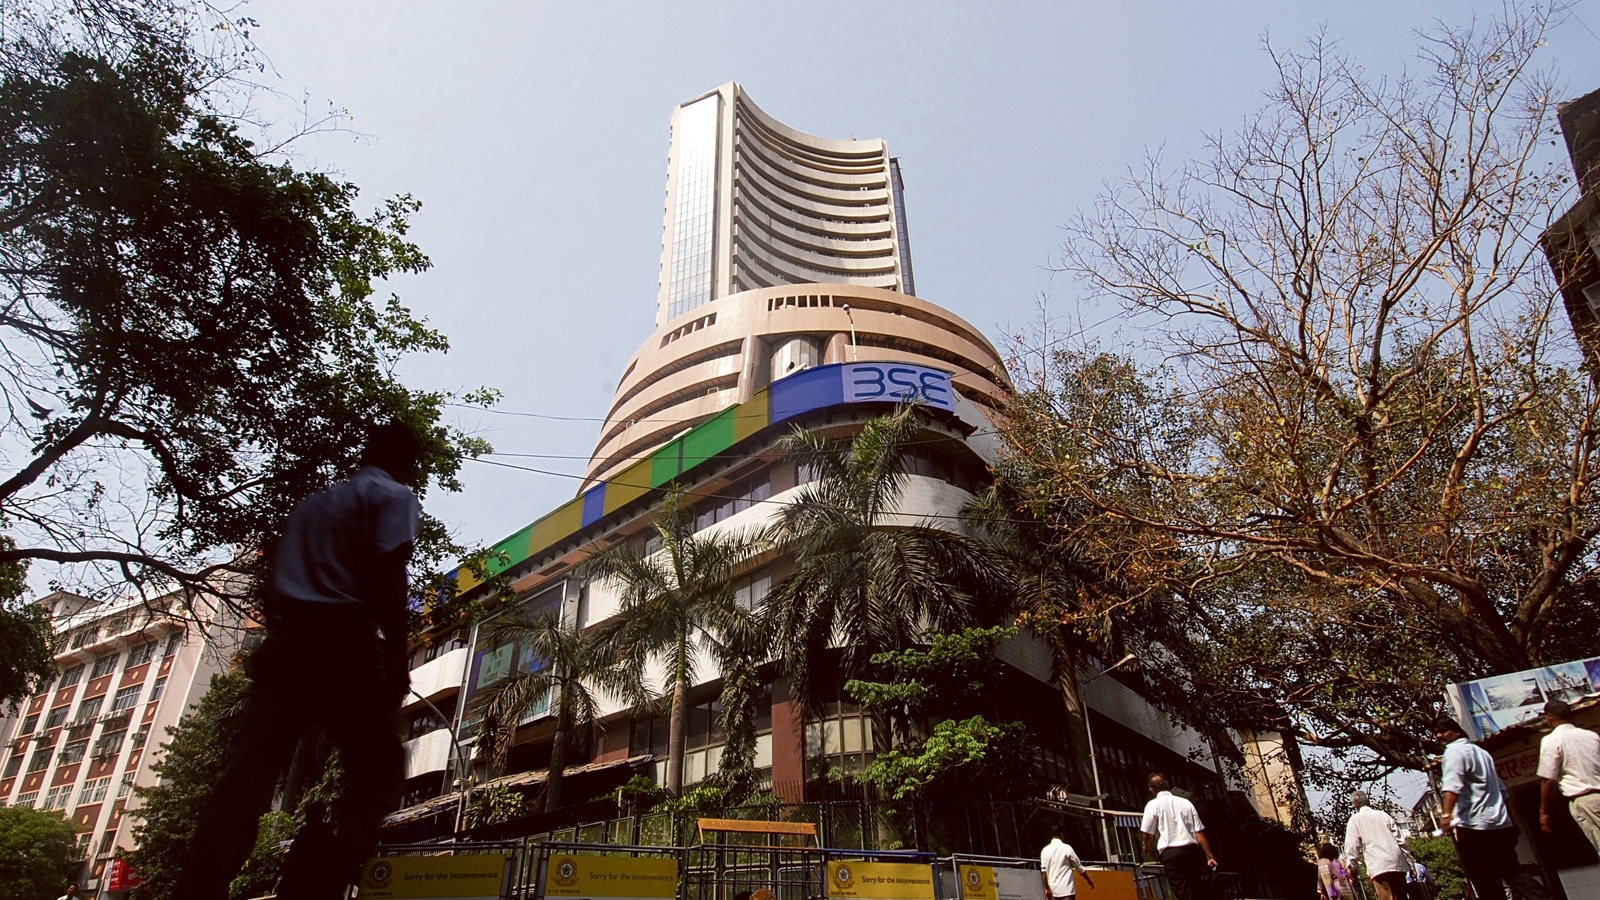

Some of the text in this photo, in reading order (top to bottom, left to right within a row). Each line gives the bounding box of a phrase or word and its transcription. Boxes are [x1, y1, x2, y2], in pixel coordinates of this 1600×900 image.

[853, 366, 949, 406] BSE
[403, 871, 498, 882] Sorry for the inconvenience
[588, 871, 674, 882] Sorry for the inconvenience
[861, 875, 930, 885] Sorry for the inconvenience
